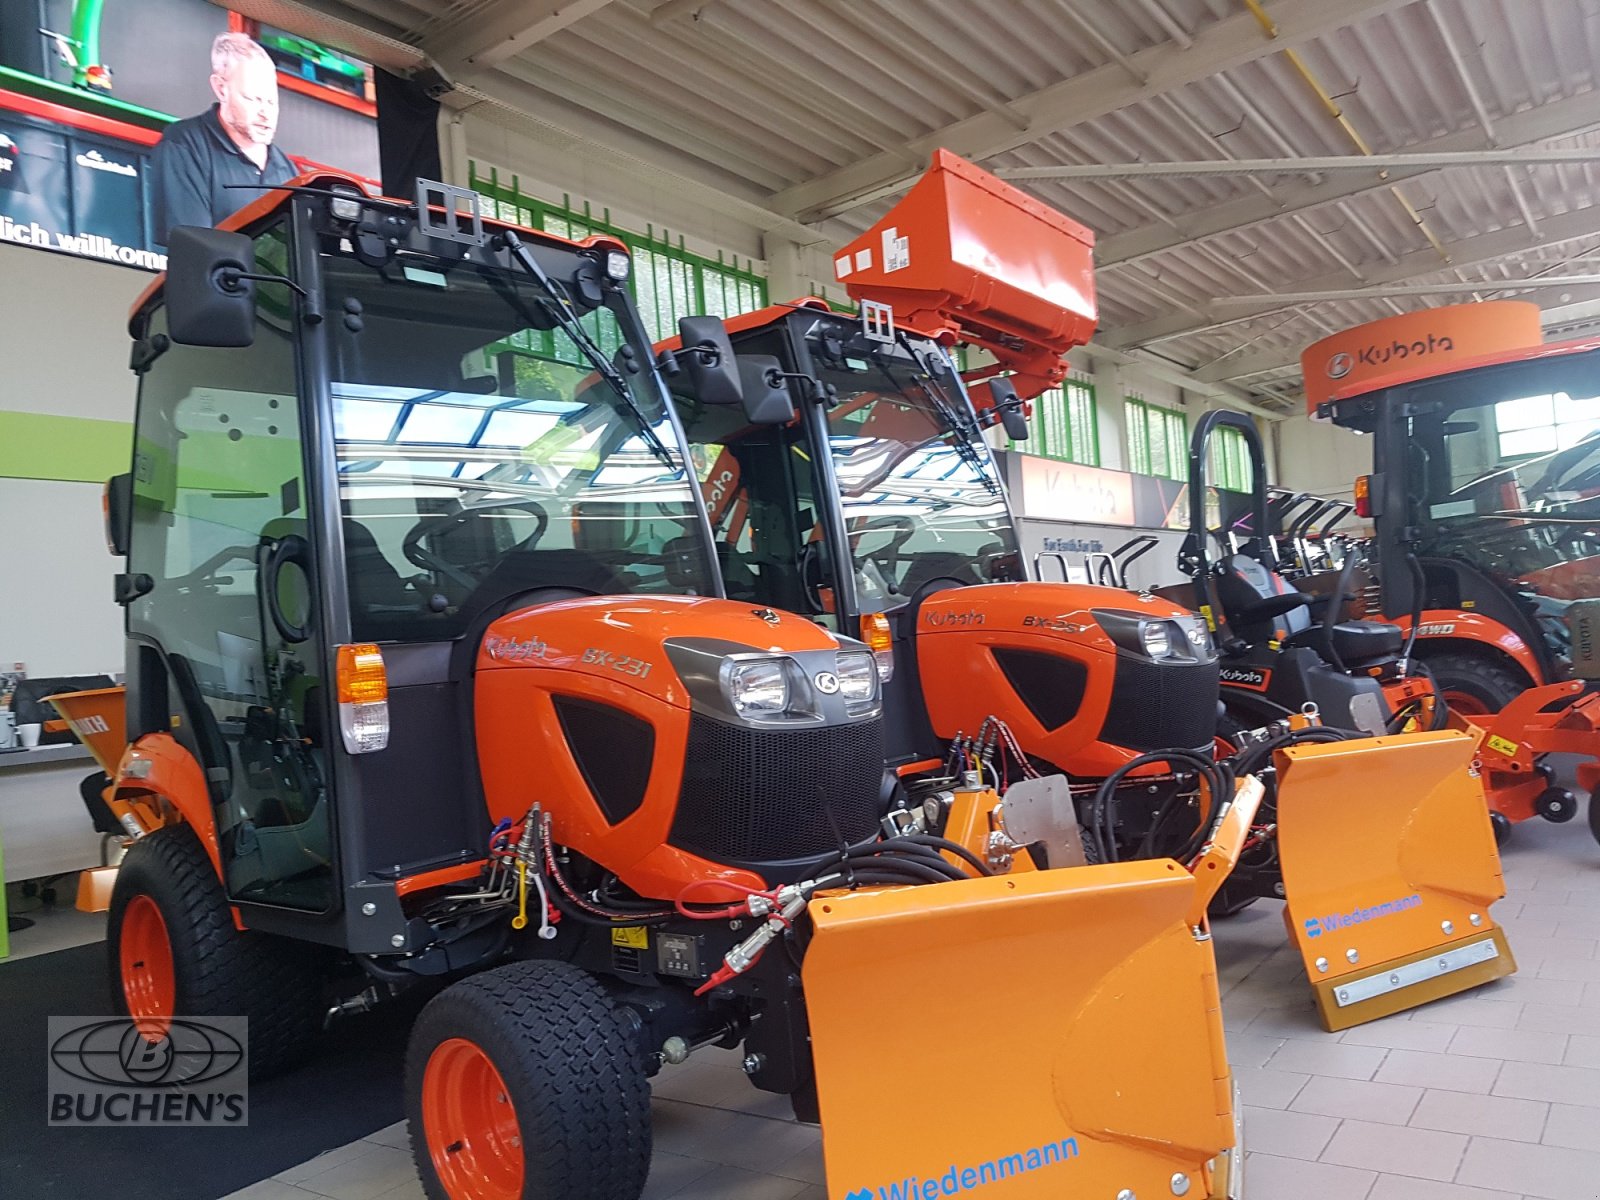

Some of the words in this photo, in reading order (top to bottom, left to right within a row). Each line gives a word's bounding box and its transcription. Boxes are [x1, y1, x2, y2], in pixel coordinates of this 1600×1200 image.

[1358, 334, 1453, 365] Kubota
[925, 610, 986, 626] Kubota
[485, 636, 547, 660] Kubota
[1219, 669, 1263, 683] Kubota
[1321, 894, 1423, 932] Wiedenmann
[878, 1136, 1079, 1200] Wiedenmann
